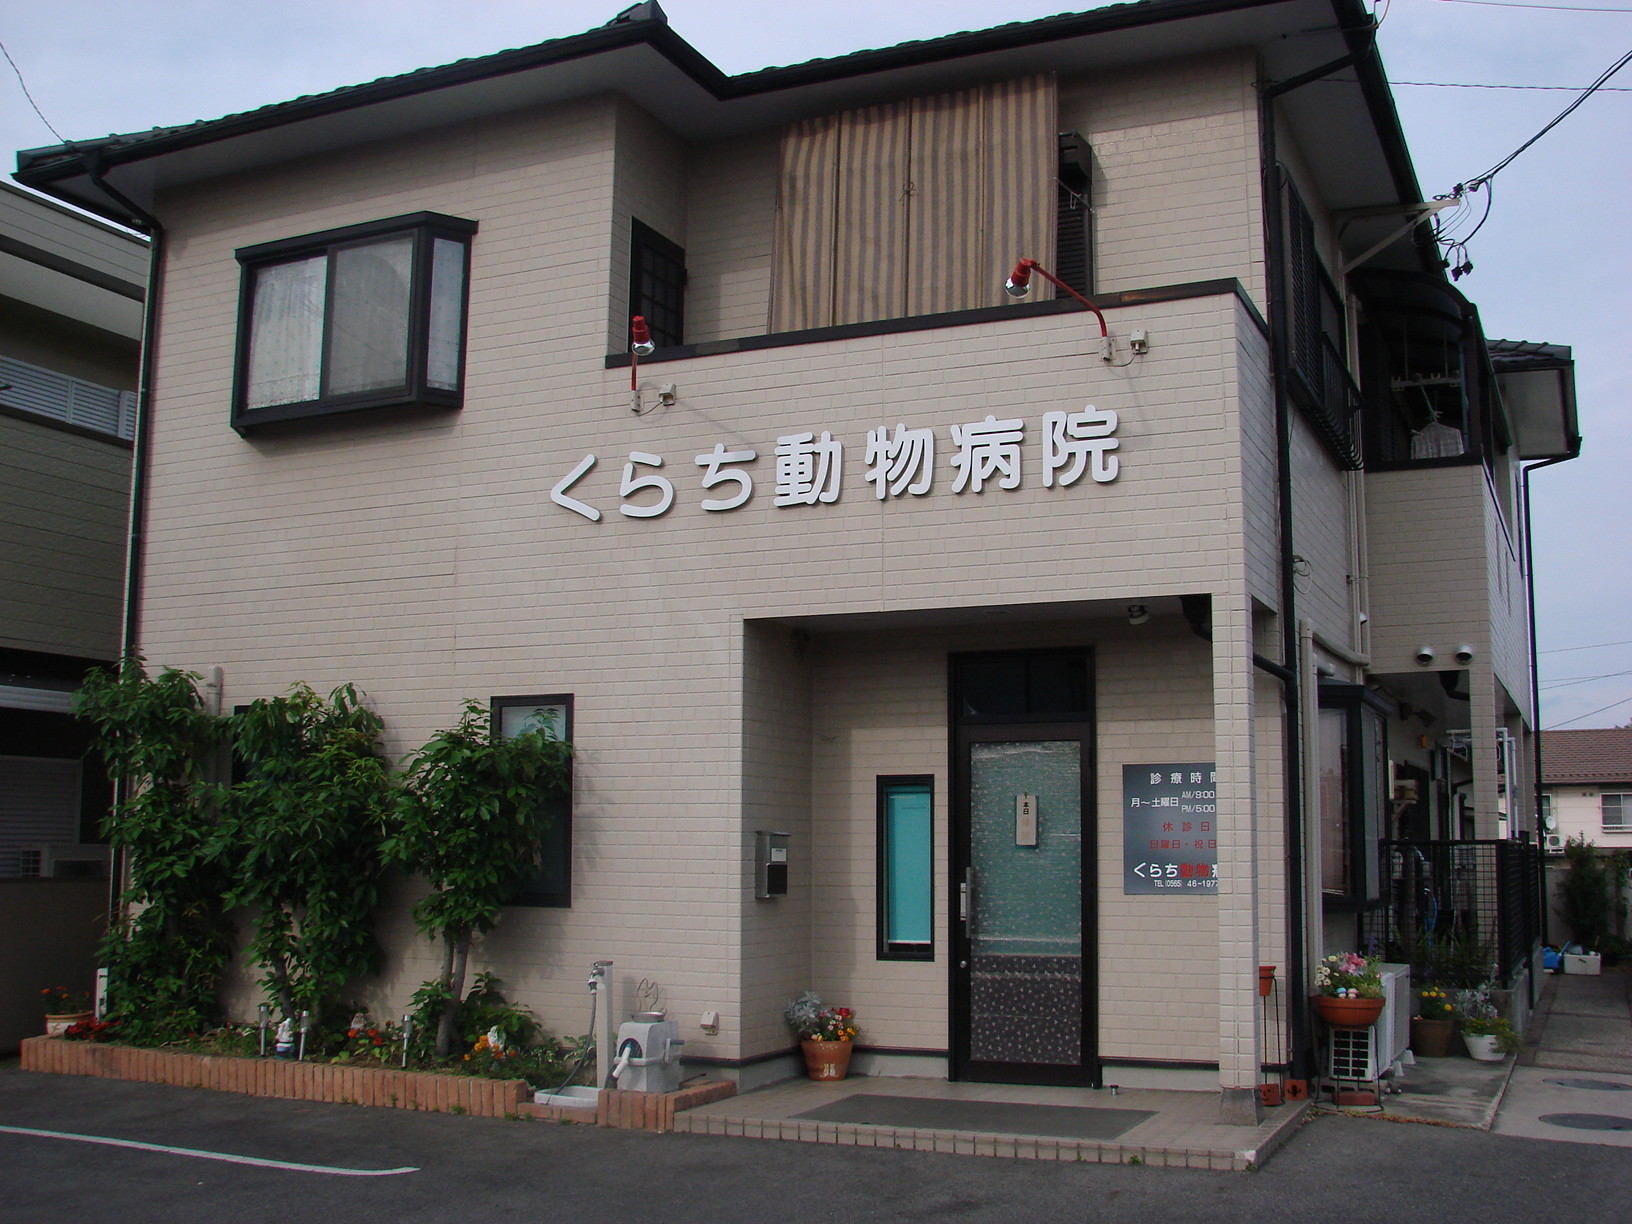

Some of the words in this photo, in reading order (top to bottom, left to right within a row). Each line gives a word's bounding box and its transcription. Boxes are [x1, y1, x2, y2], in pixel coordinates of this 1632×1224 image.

[550, 405, 1120, 522] くらち動物病院
[1163, 821, 1210, 832] 休診日
